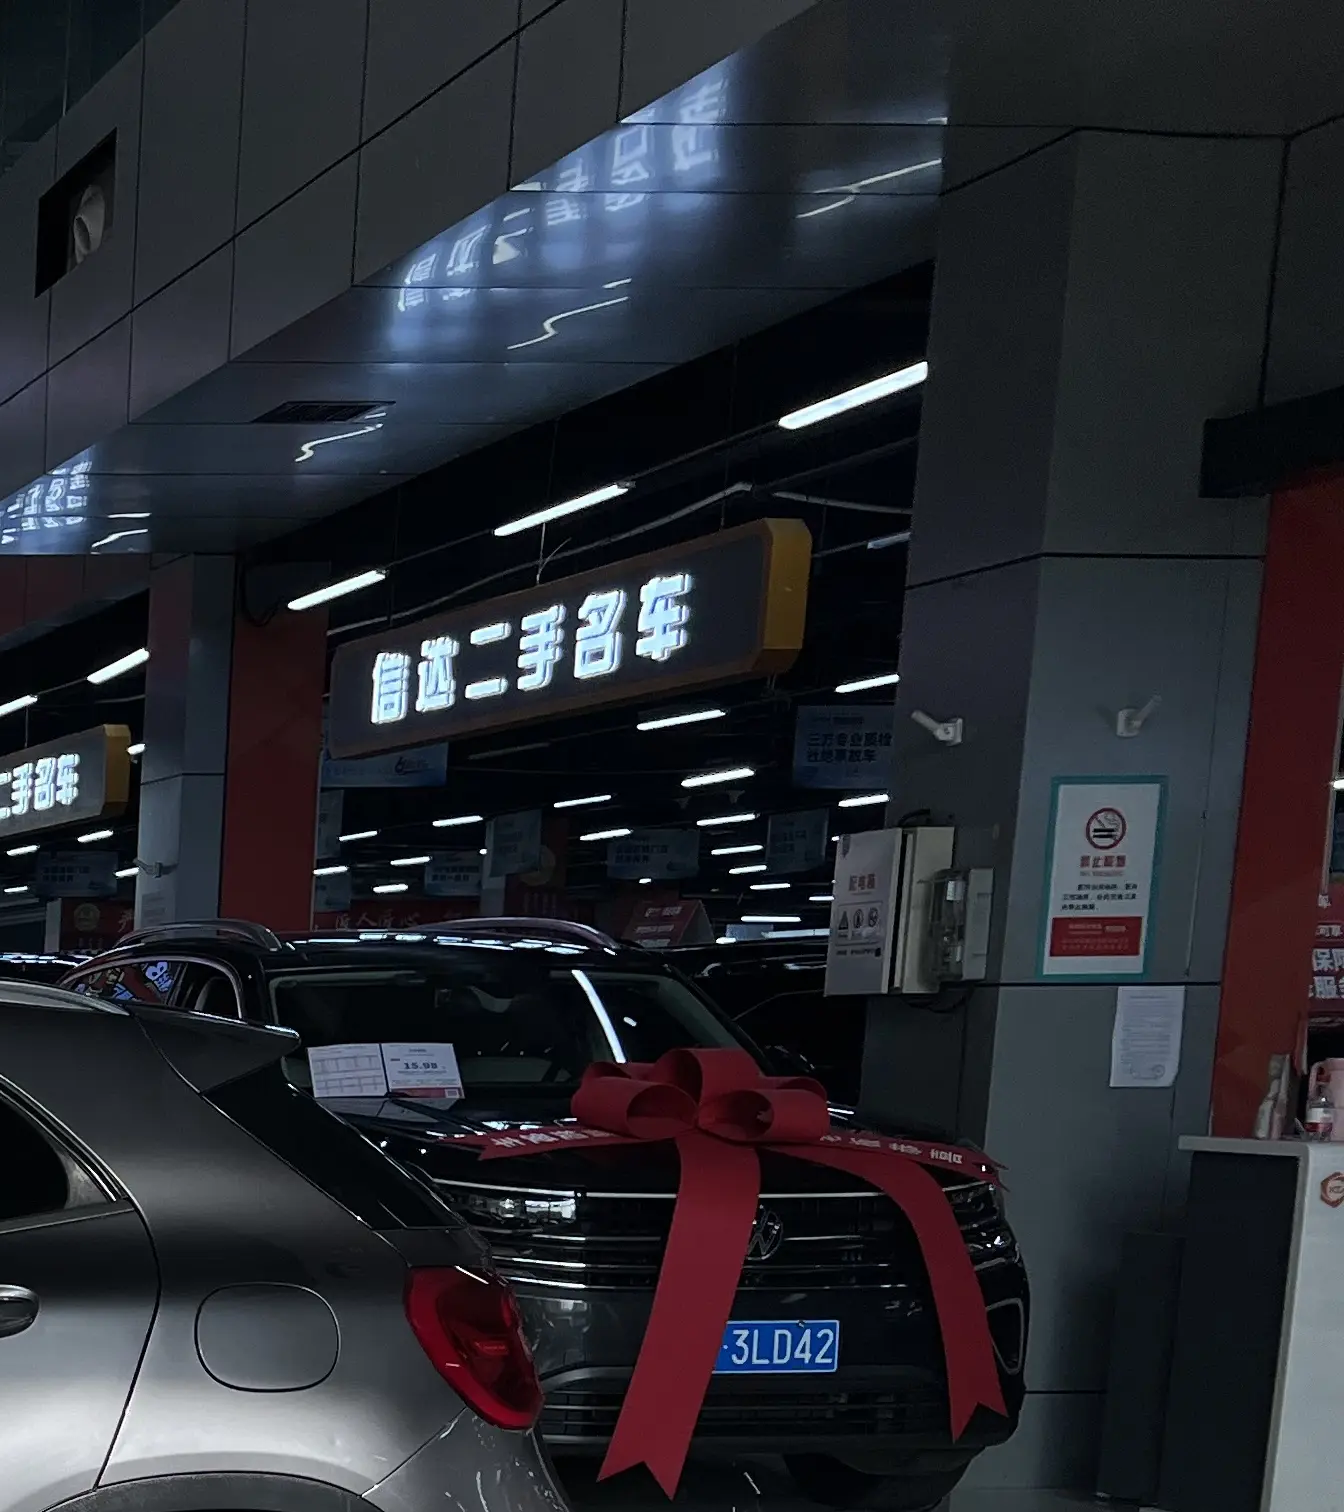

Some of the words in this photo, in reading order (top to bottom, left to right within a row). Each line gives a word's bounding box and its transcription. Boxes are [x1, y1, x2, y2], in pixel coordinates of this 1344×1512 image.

[370, 572, 694, 726] 信达二手名车
